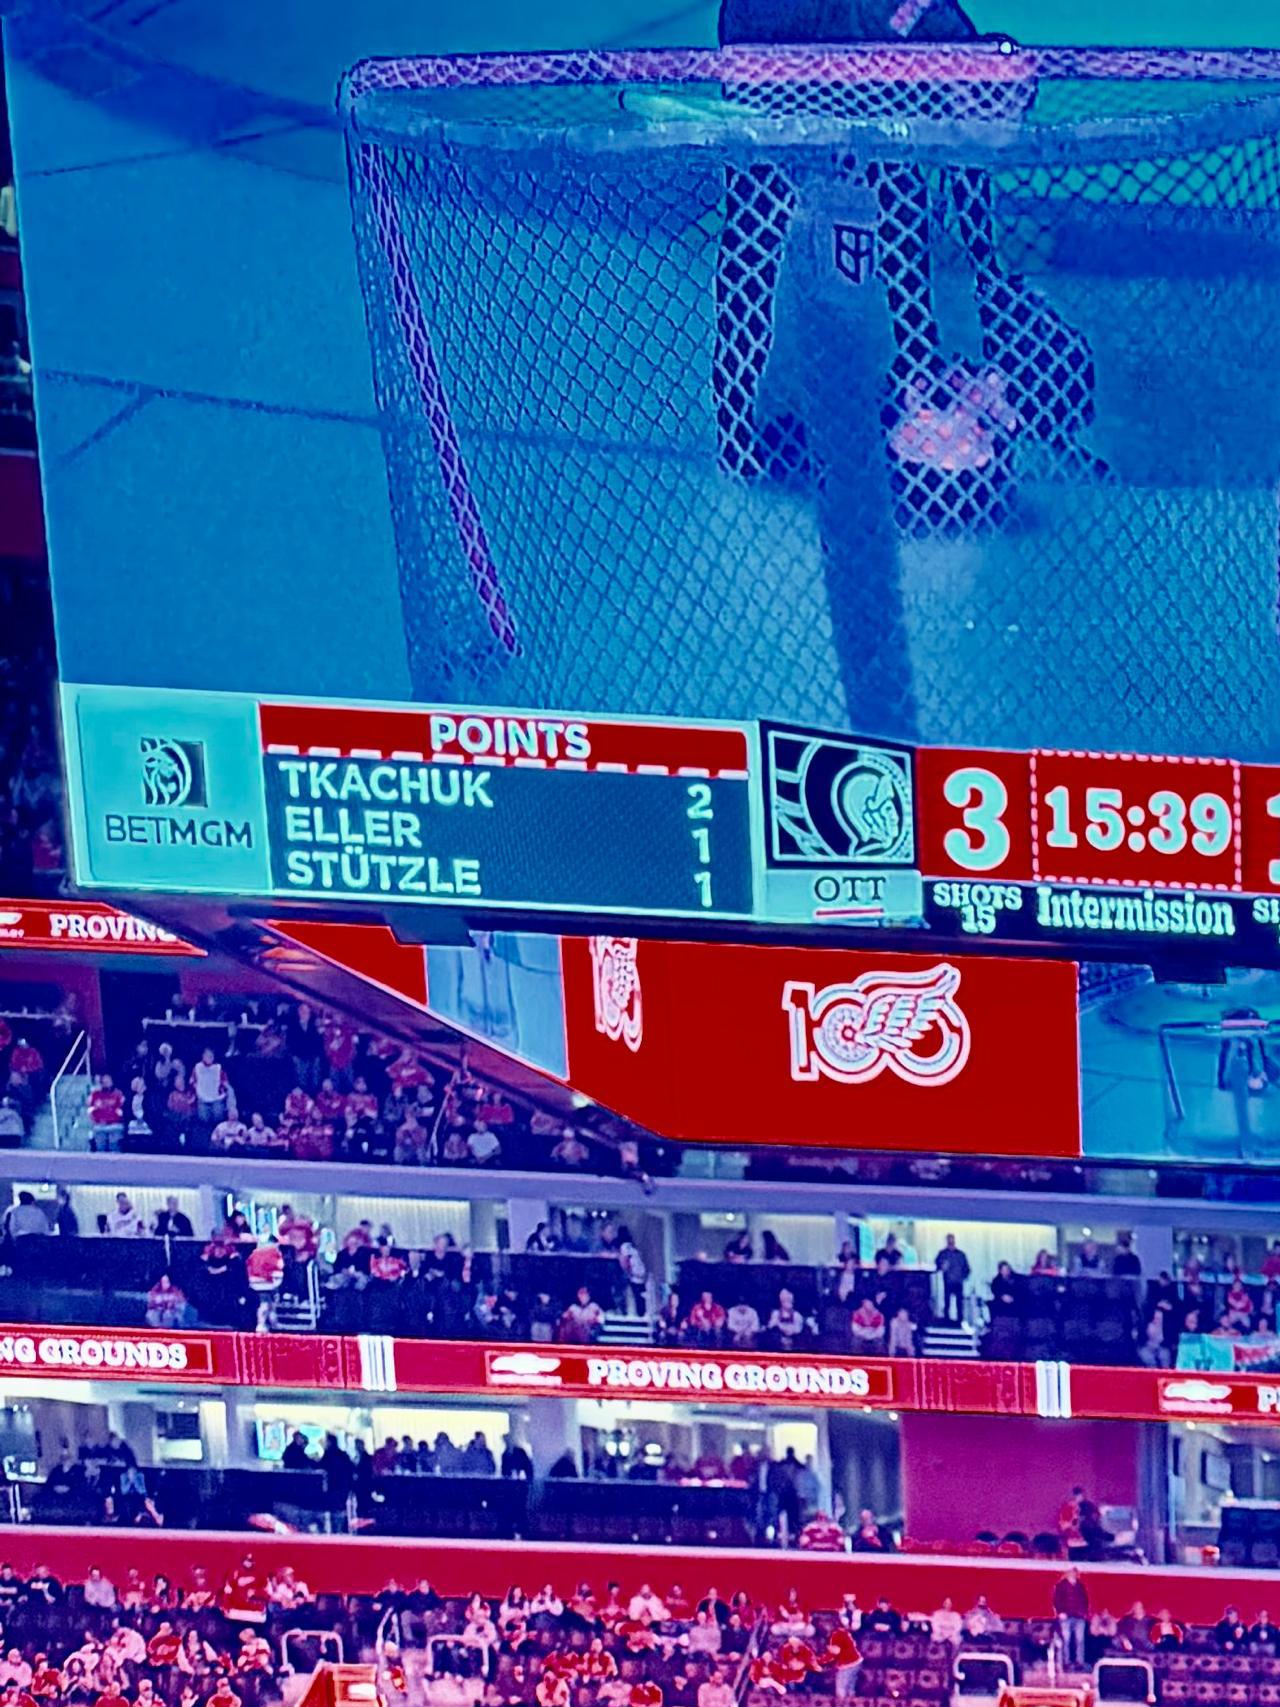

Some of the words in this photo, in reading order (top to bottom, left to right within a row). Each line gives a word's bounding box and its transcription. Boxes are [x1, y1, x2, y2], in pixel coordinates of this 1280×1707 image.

[430, 715, 591, 760] POINTS
[278, 761, 494, 809] TKACHUK
[687, 784, 713, 819] 2
[105, 814, 254, 849] BETMGM
[285, 806, 422, 848] ELLER
[692, 828, 711, 864] 1
[943, 767, 1011, 871] 3
[1044, 785, 1232, 857] 15:39
[287, 846, 482, 896] STÜTZLE
[694, 871, 713, 908] 1
[814, 876, 887, 902] OTT
[932, 882, 1024, 911] SHOTS
[961, 905, 997, 934] 15
[1036, 886, 1236, 936] Intermission
[39, 1338, 188, 1370] GROUNDS
[586, 1359, 723, 1391] PROVING
[723, 1363, 870, 1396] GROUNDS
